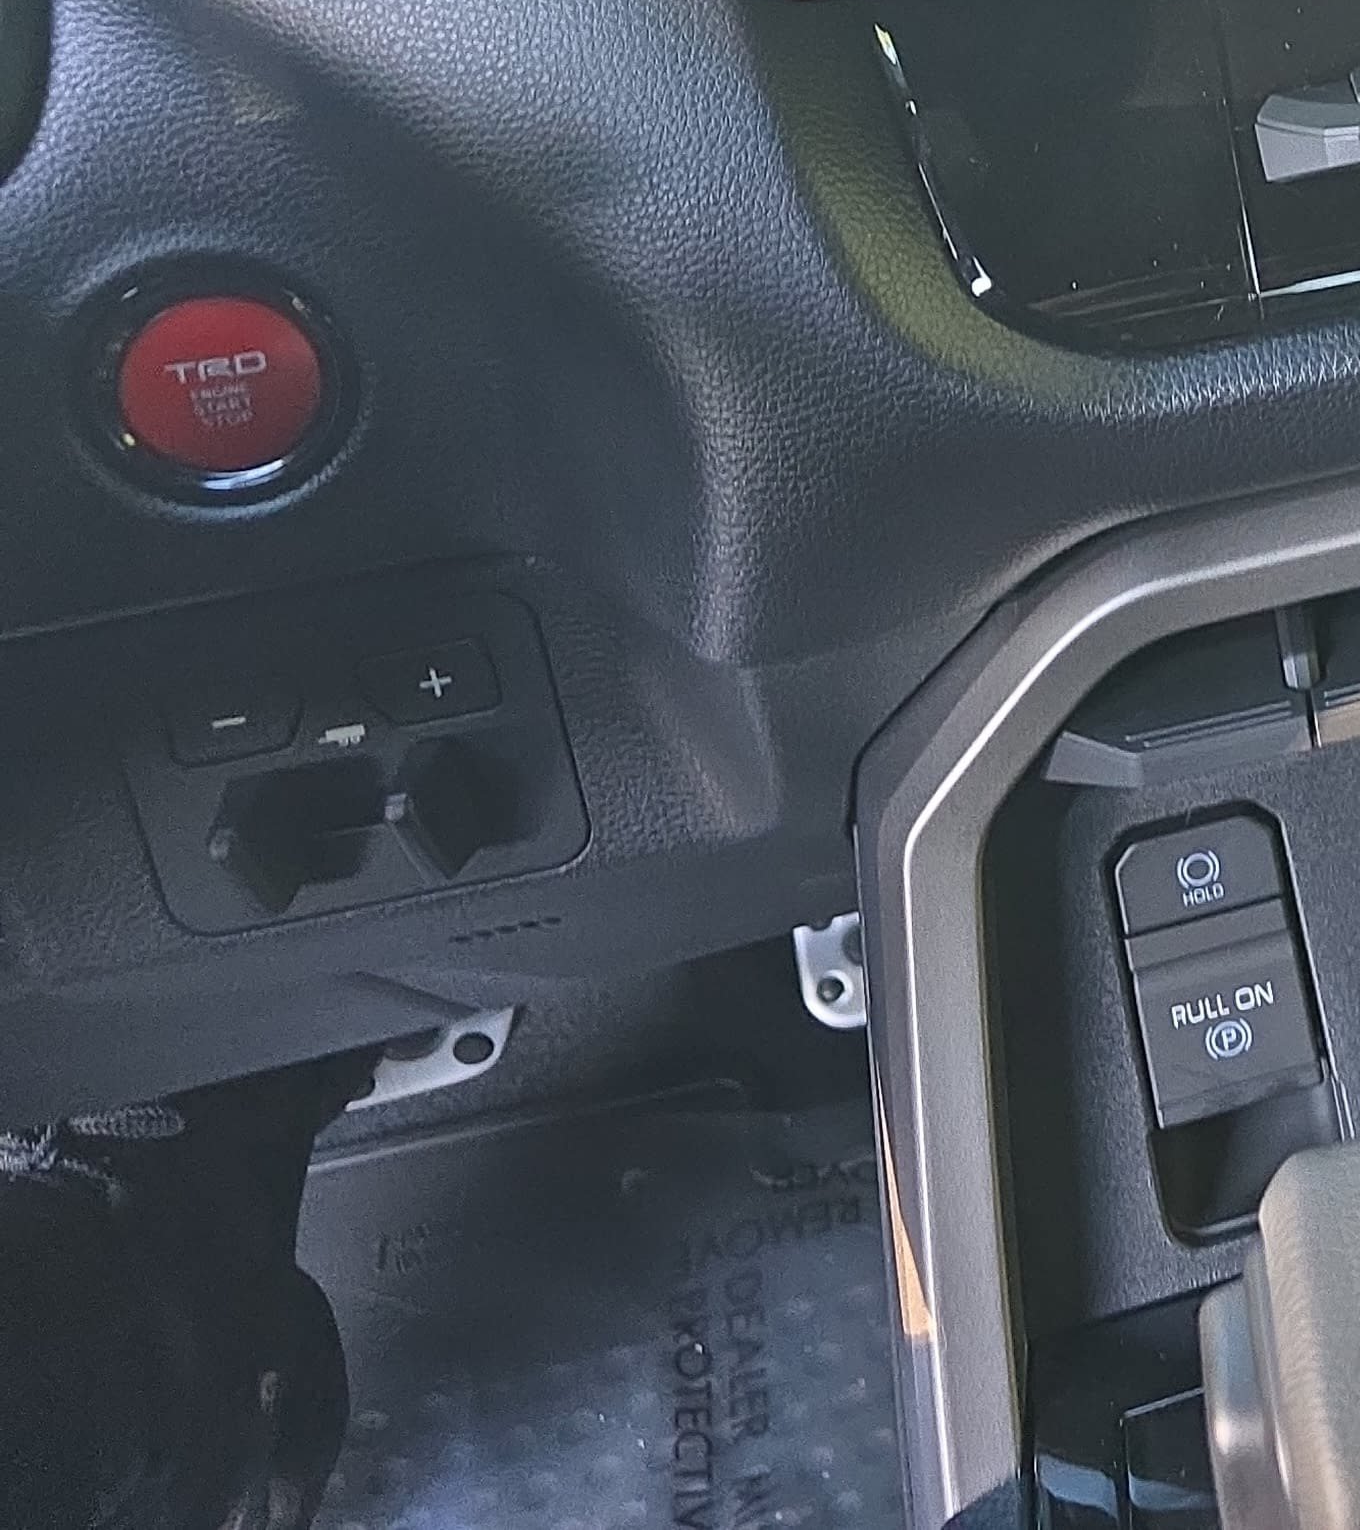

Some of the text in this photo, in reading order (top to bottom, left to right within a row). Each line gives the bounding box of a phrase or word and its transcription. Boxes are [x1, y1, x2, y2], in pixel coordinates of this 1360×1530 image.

[163, 350, 268, 385] TRD
[1182, 882, 1225, 908] HOLD
[1171, 980, 1275, 1030] PULL ON
